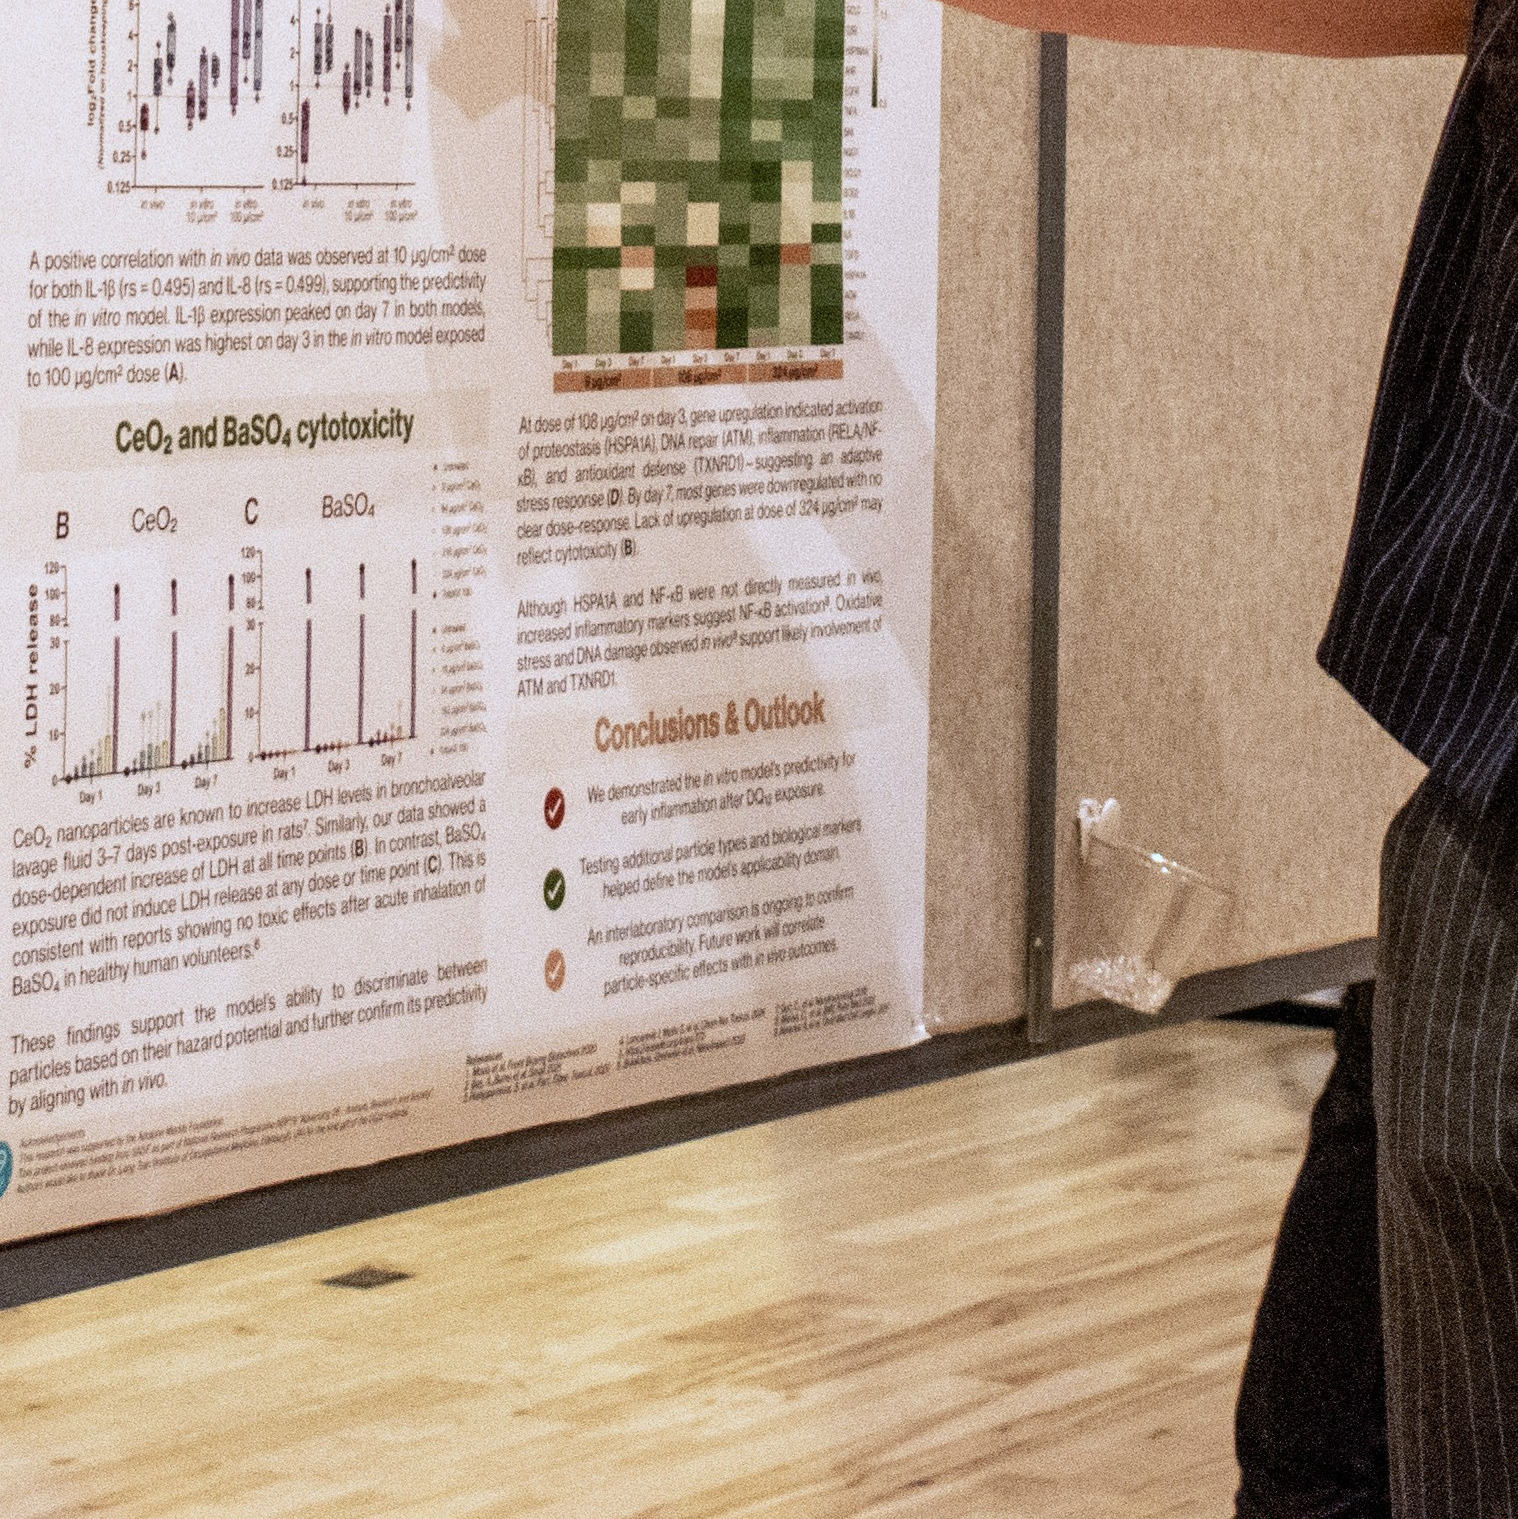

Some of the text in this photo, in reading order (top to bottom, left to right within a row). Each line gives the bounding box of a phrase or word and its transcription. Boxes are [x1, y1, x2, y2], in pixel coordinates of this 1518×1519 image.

[28, 250, 41, 270] A
[43, 252, 97, 273] positive
[100, 250, 175, 269] correlation
[177, 249, 207, 268] with
[209, 252, 223, 266] in
[225, 252, 252, 267] vivo
[253, 248, 284, 267] data
[286, 251, 313, 266] was
[315, 246, 374, 266] observed
[376, 247, 390, 264] at
[393, 245, 408, 265] 10
[456, 245, 488, 264] dose
[177, 416, 218, 450] and
[297, 408, 414, 449] cytotoxicity
[55, 511, 71, 539] B
[243, 498, 260, 525] C
[28, 583, 39, 675] release
[25, 683, 38, 736] LDH
[595, 690, 826, 753] Conclusions & Outlook
[56, 815, 150, 842] nanoparticles
[152, 813, 176, 830] are
[179, 807, 225, 826] known
[227, 803, 243, 820] to
[245, 797, 302, 817] increase
[305, 789, 334, 810] LDH
[336, 785, 373, 805] levels
[375, 785, 388, 799] in
[390, 771, 487, 798] bronchoalveolar
